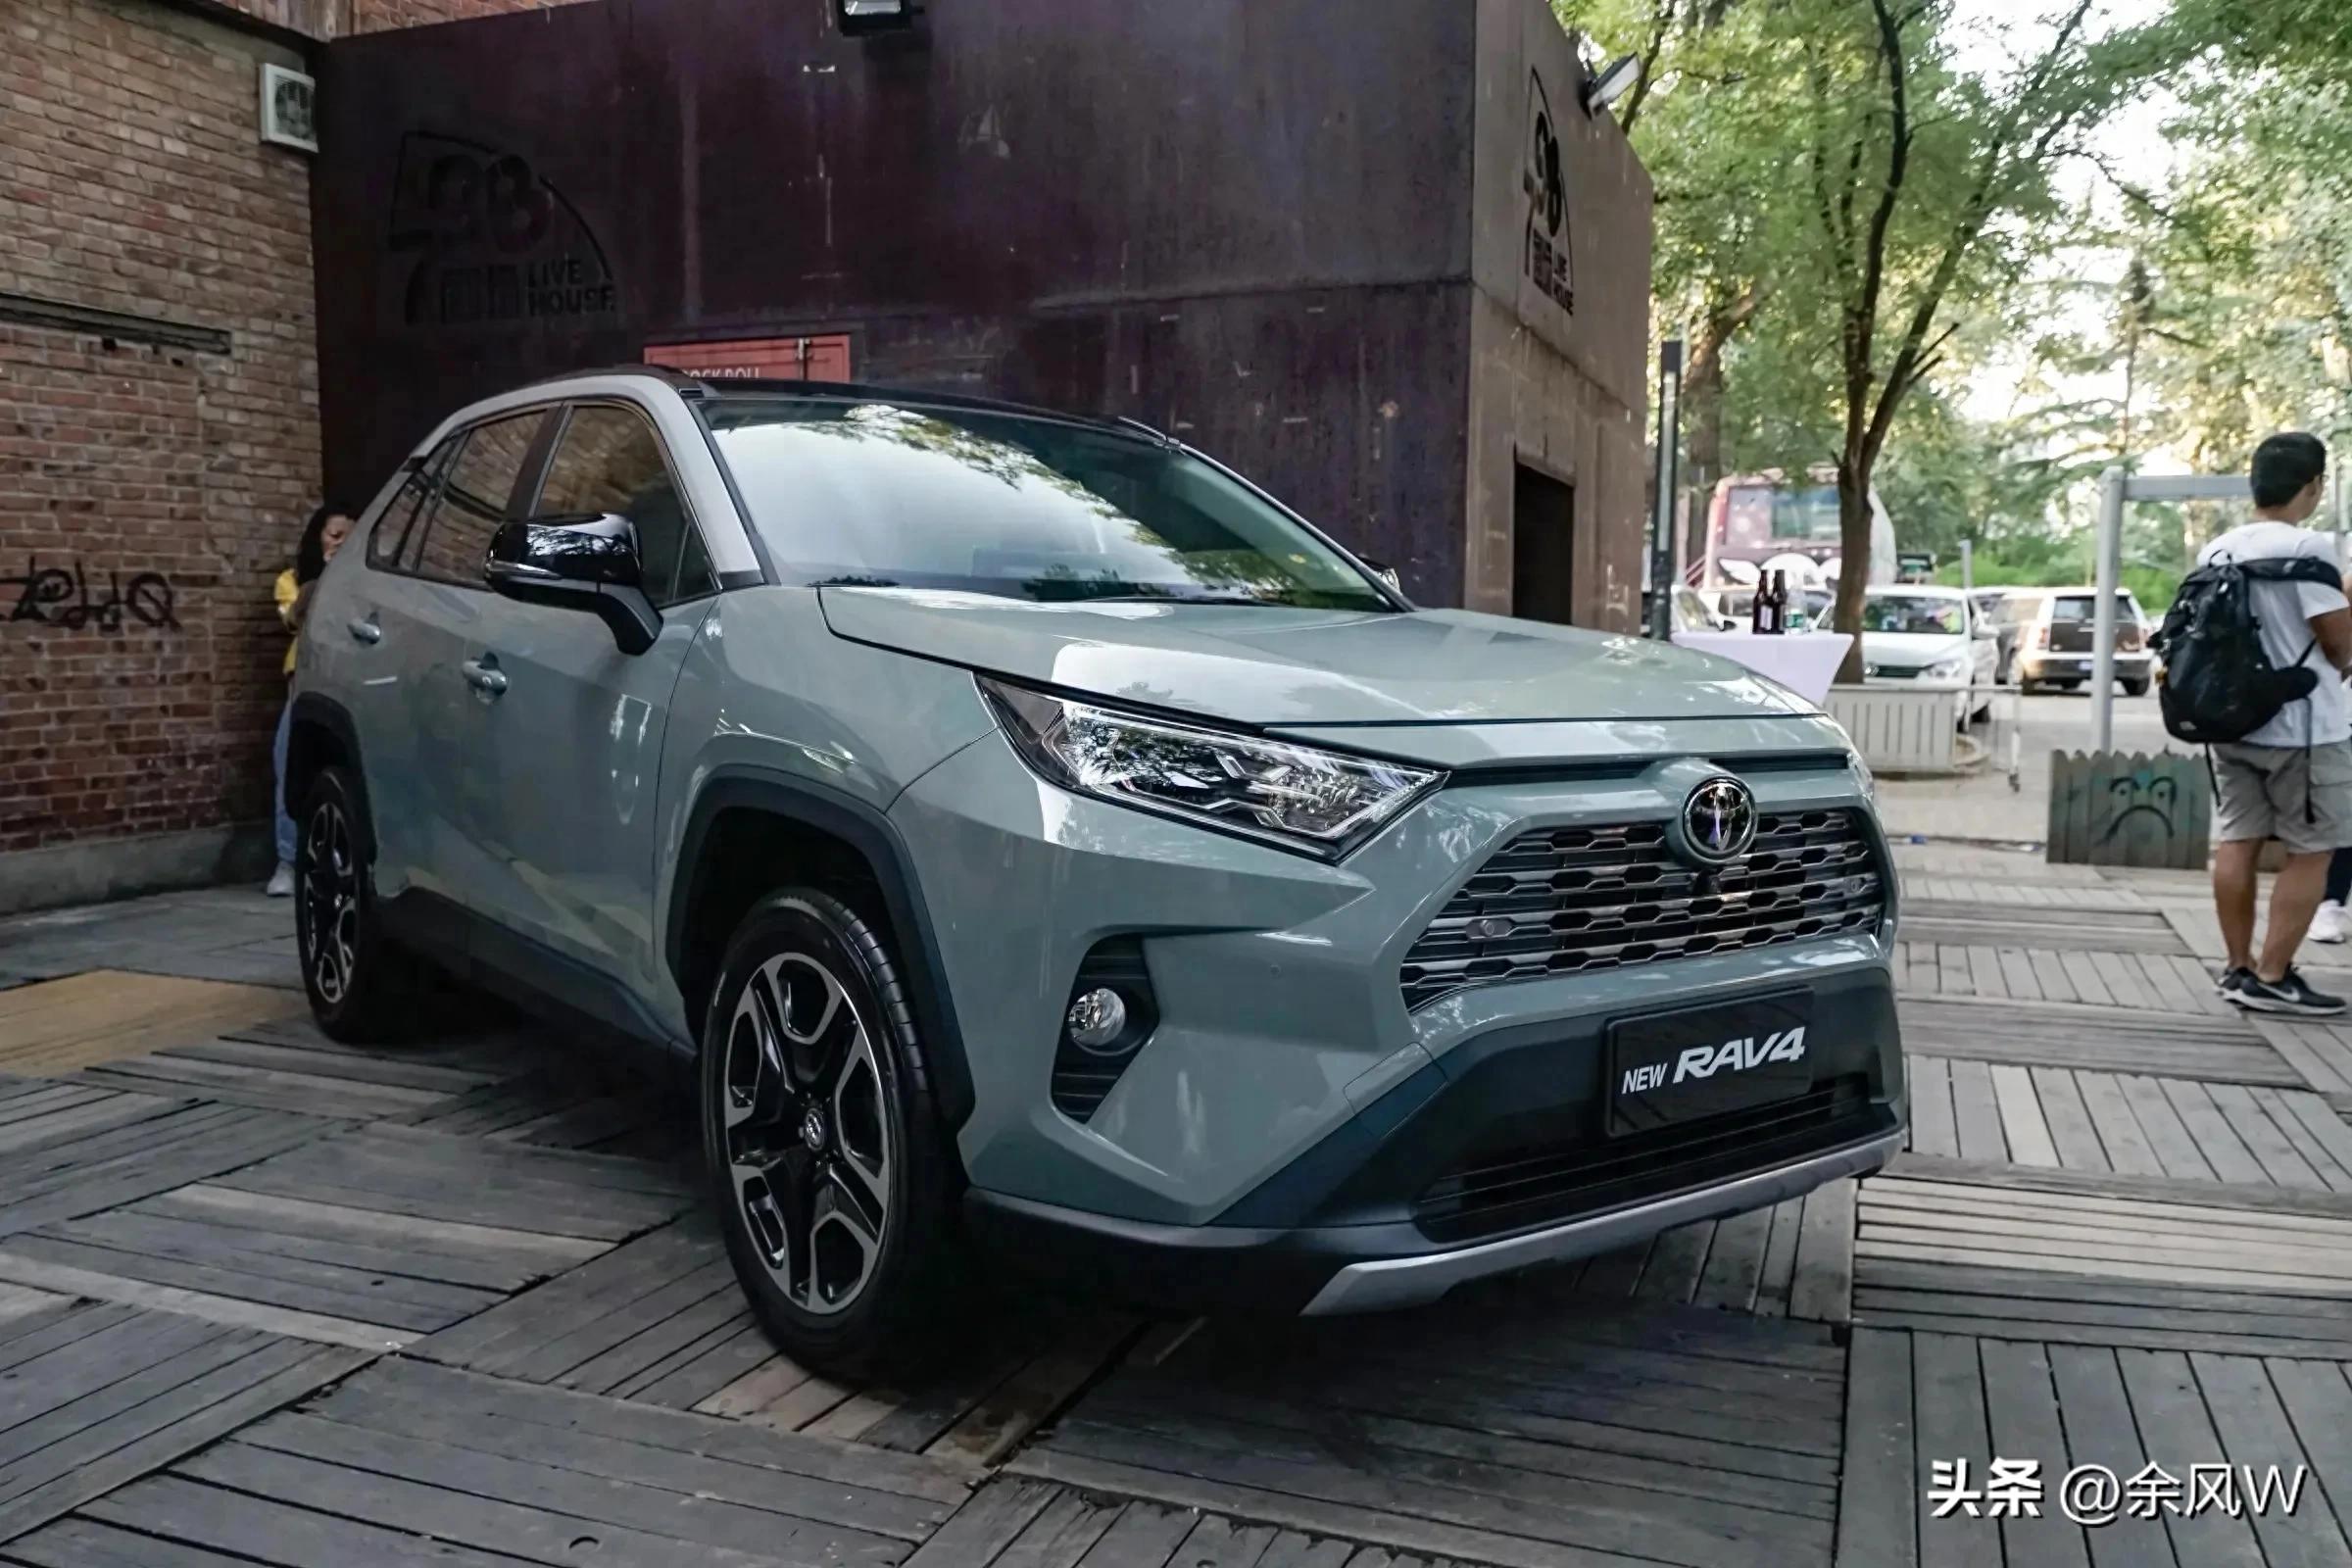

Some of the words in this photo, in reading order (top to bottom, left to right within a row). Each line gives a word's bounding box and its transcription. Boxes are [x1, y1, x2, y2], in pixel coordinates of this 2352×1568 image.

[527, 259, 583, 287] LIVE
[1622, 1062, 1668, 1095] NEW
[1673, 1026, 1806, 1084] RAV4
